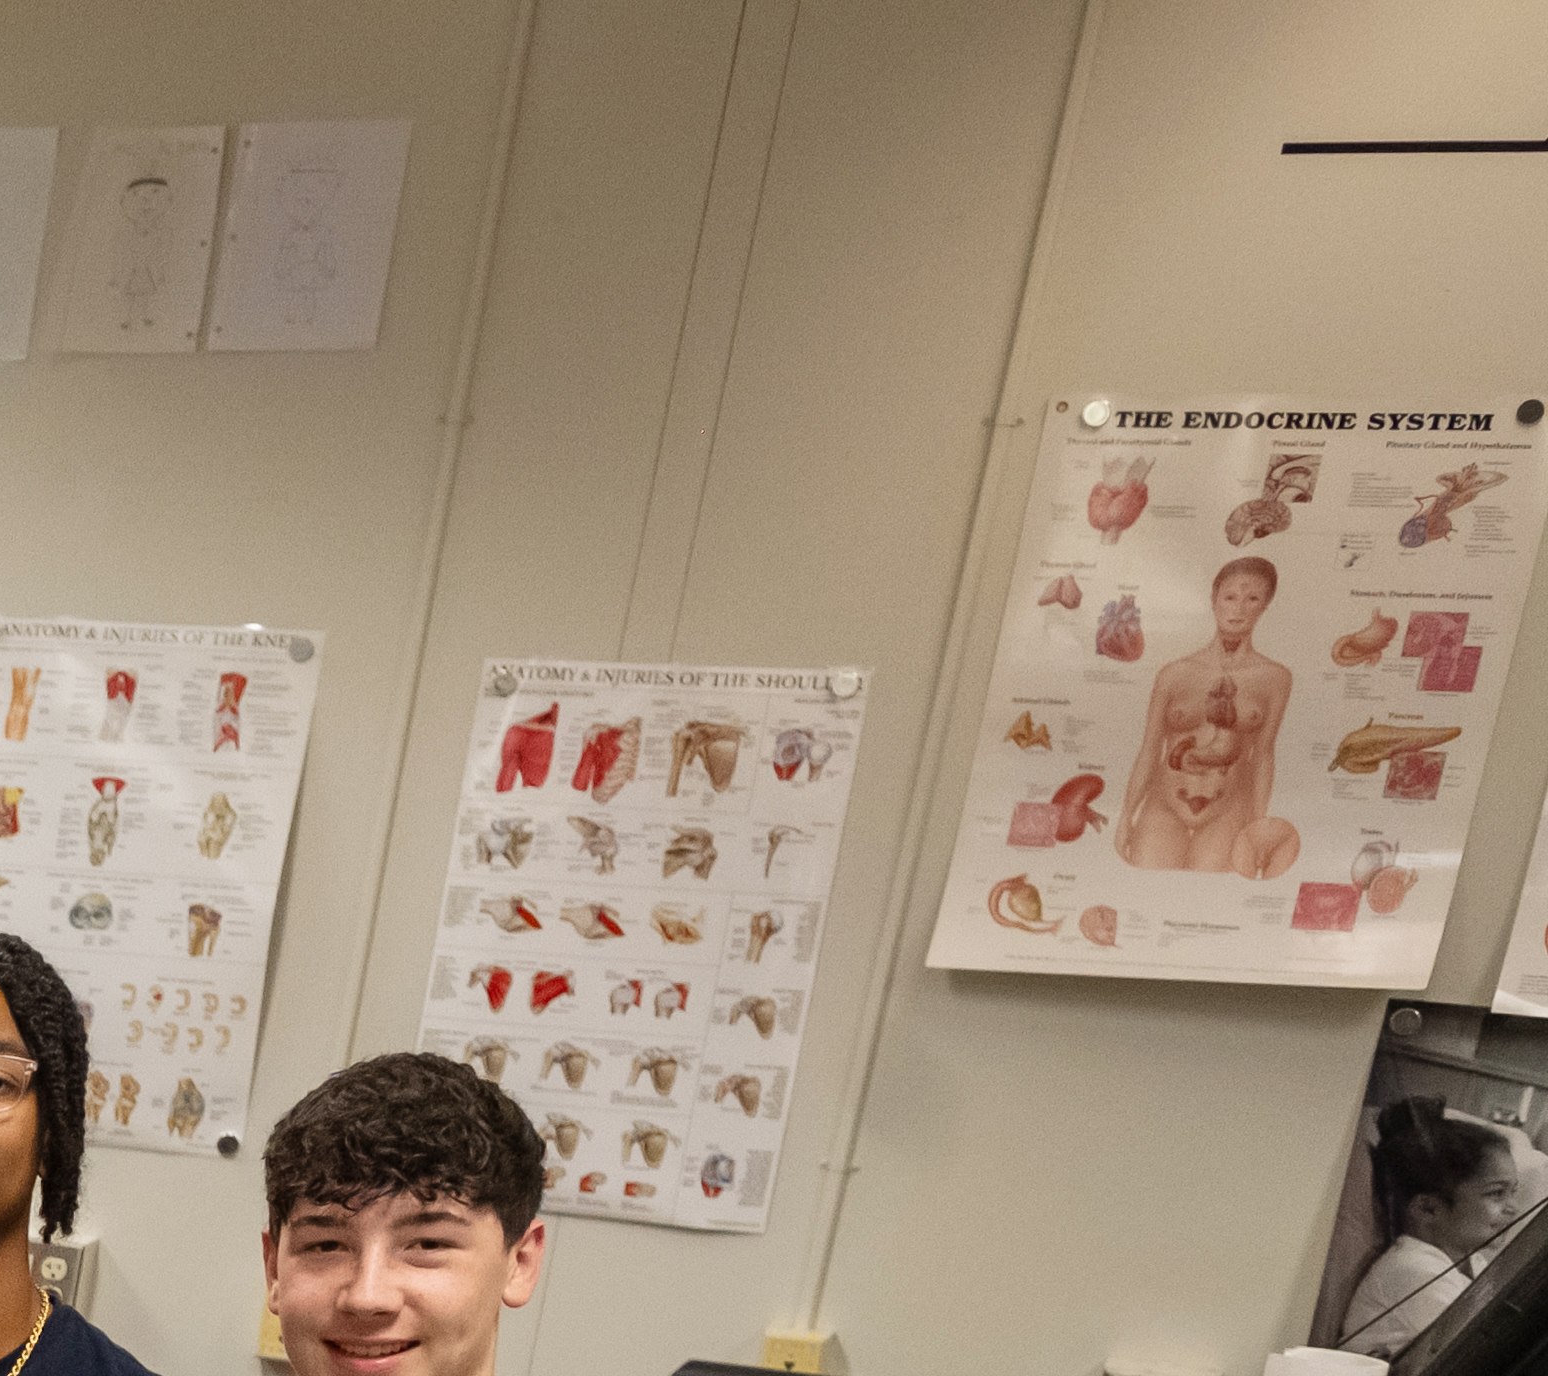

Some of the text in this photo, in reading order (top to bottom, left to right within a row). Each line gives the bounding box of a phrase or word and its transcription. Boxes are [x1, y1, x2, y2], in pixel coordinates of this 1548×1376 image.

[1115, 410, 1494, 432] THE ENDOCRINE SYSTEM
[251, 633, 288, 649] KNE
[595, 668, 674, 687] INJURIES
[679, 673, 703, 687] OF
[712, 673, 749, 688] THE
